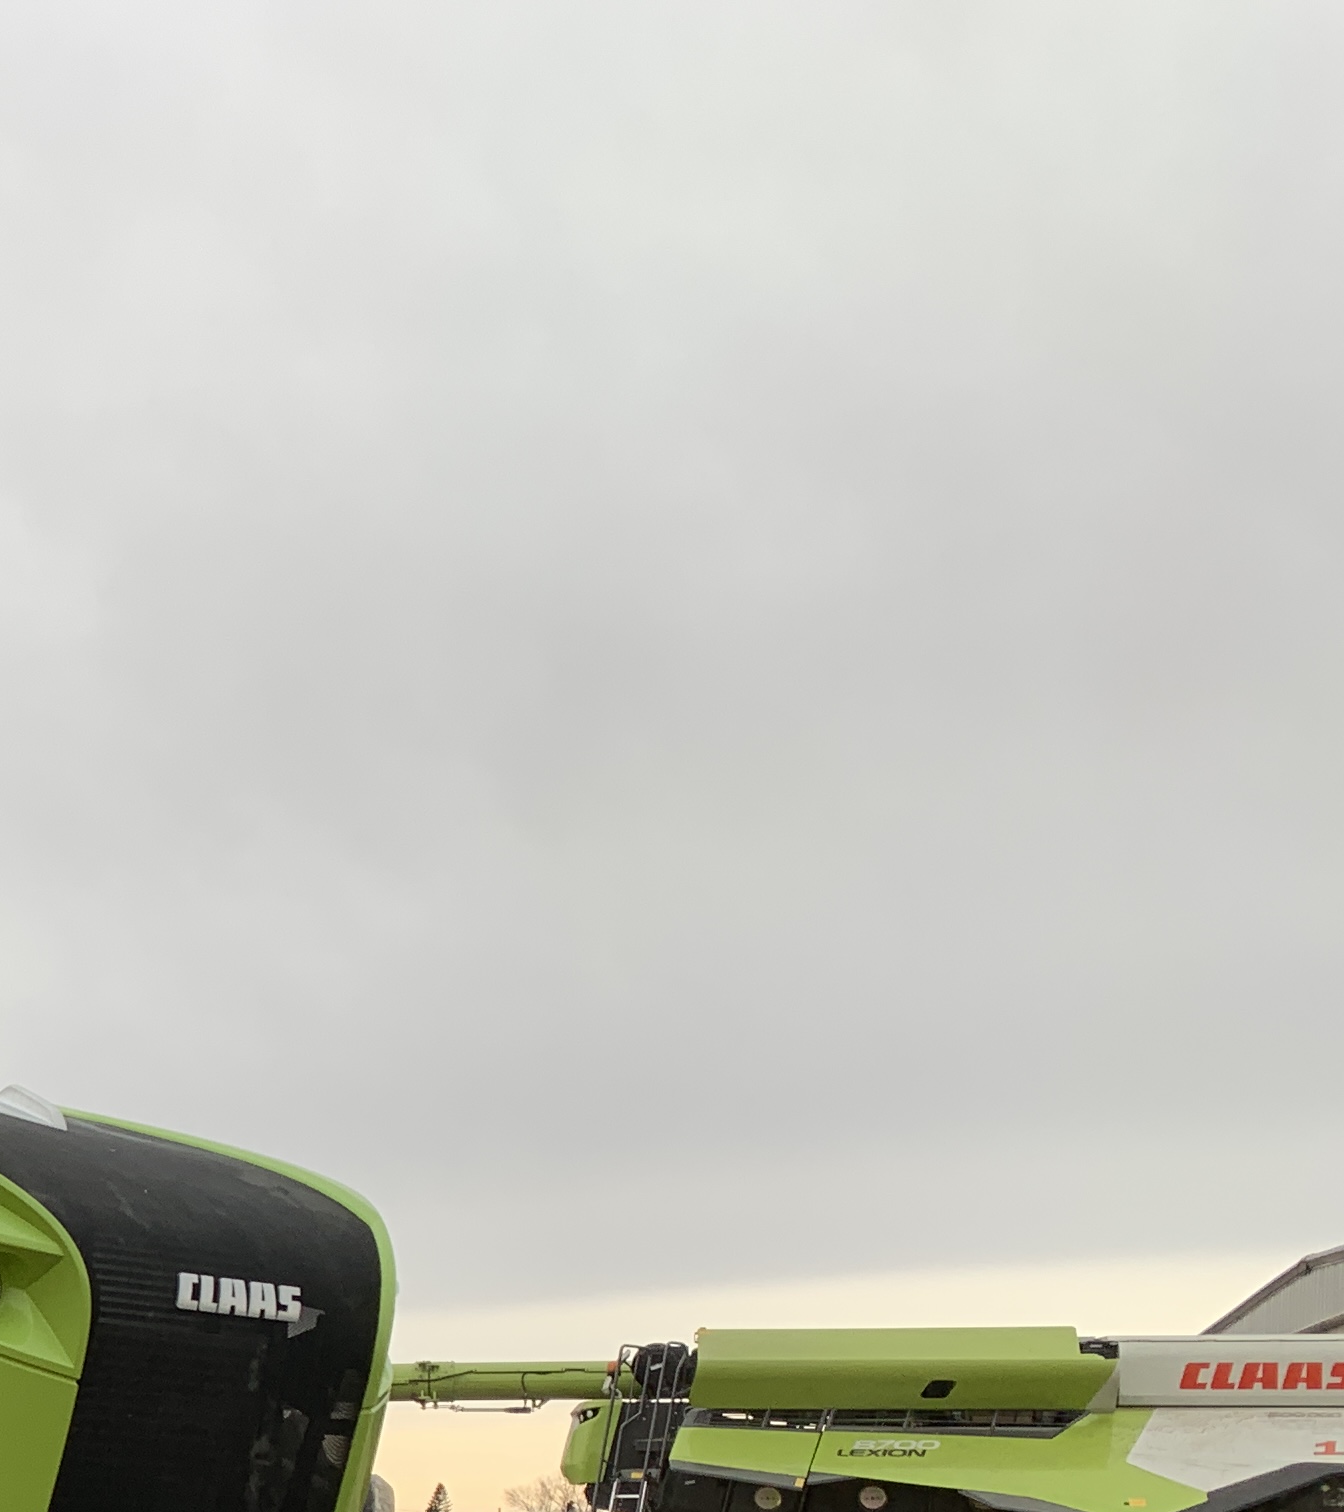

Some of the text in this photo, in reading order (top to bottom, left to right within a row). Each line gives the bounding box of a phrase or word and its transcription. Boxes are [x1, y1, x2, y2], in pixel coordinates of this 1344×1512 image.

[176, 1271, 302, 1323] CLAAS
[852, 1439, 942, 1450] 8700
[836, 1448, 928, 1458] LEXION
